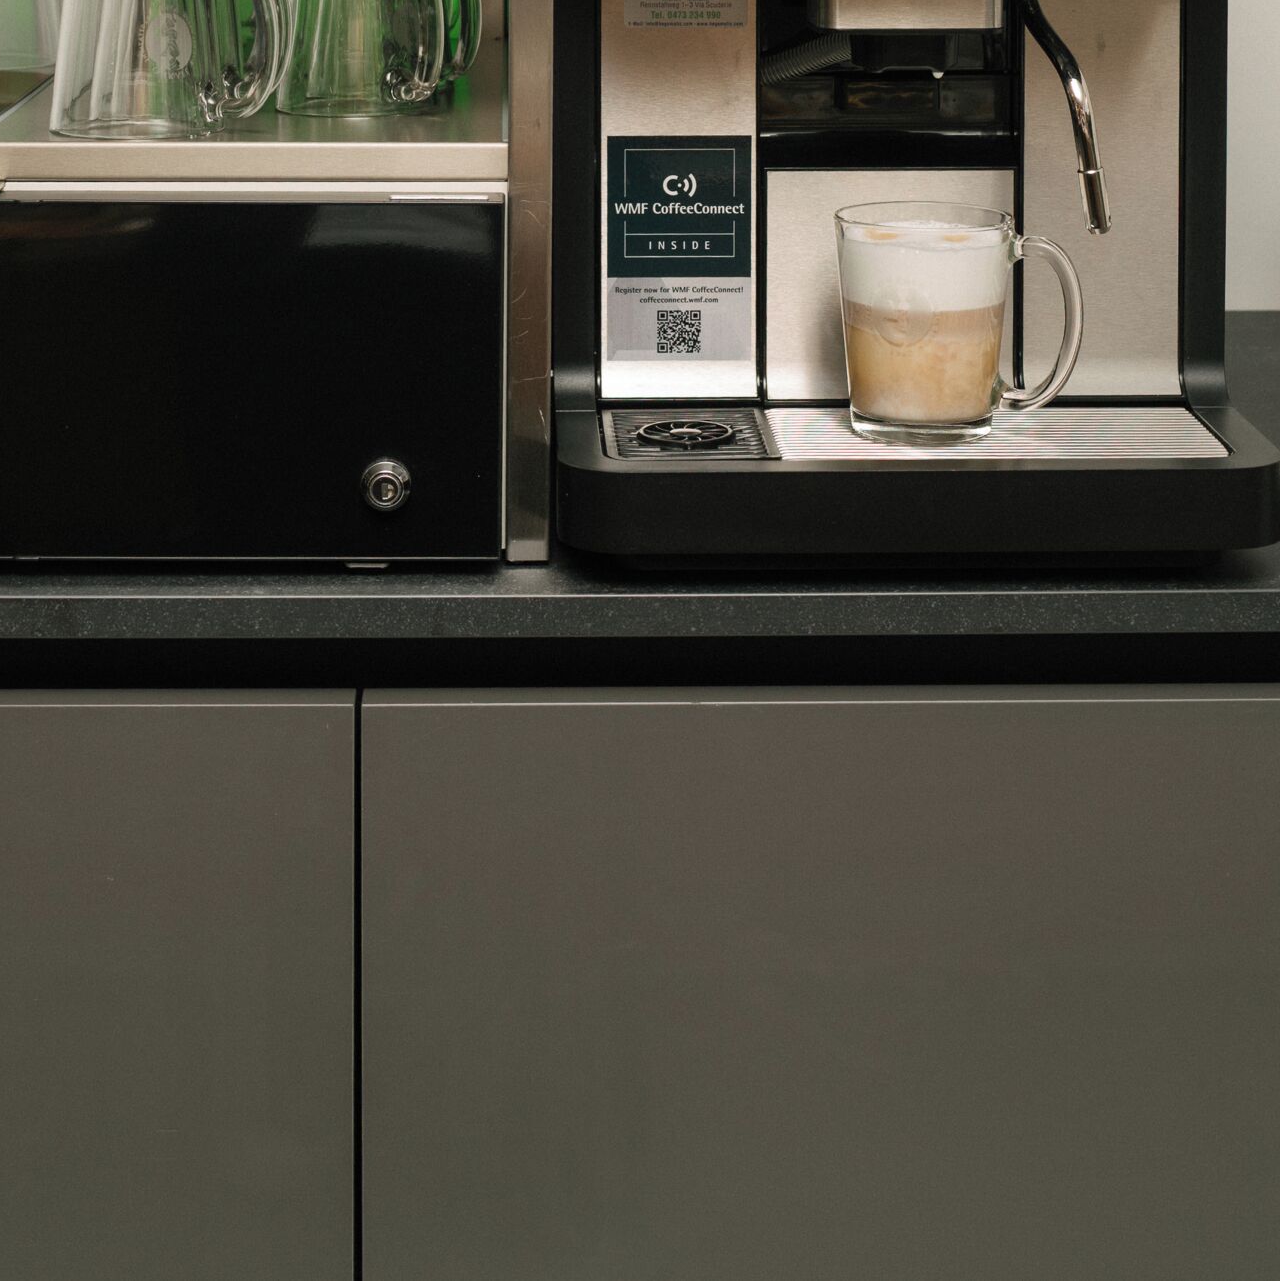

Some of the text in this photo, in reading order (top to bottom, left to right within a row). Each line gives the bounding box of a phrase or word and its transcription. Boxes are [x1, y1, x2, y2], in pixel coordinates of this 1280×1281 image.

[651, 11, 665, 19] Tel.
[615, 202, 745, 215] WMF CoffeeConnect
[648, 240, 711, 250] INSIDE
[615, 286, 642, 295] Register
[660, 286, 670, 294] for
[691, 286, 744, 294] CoffeeConnect!
[639, 296, 719, 304] coffeeconnect.wmf.com
